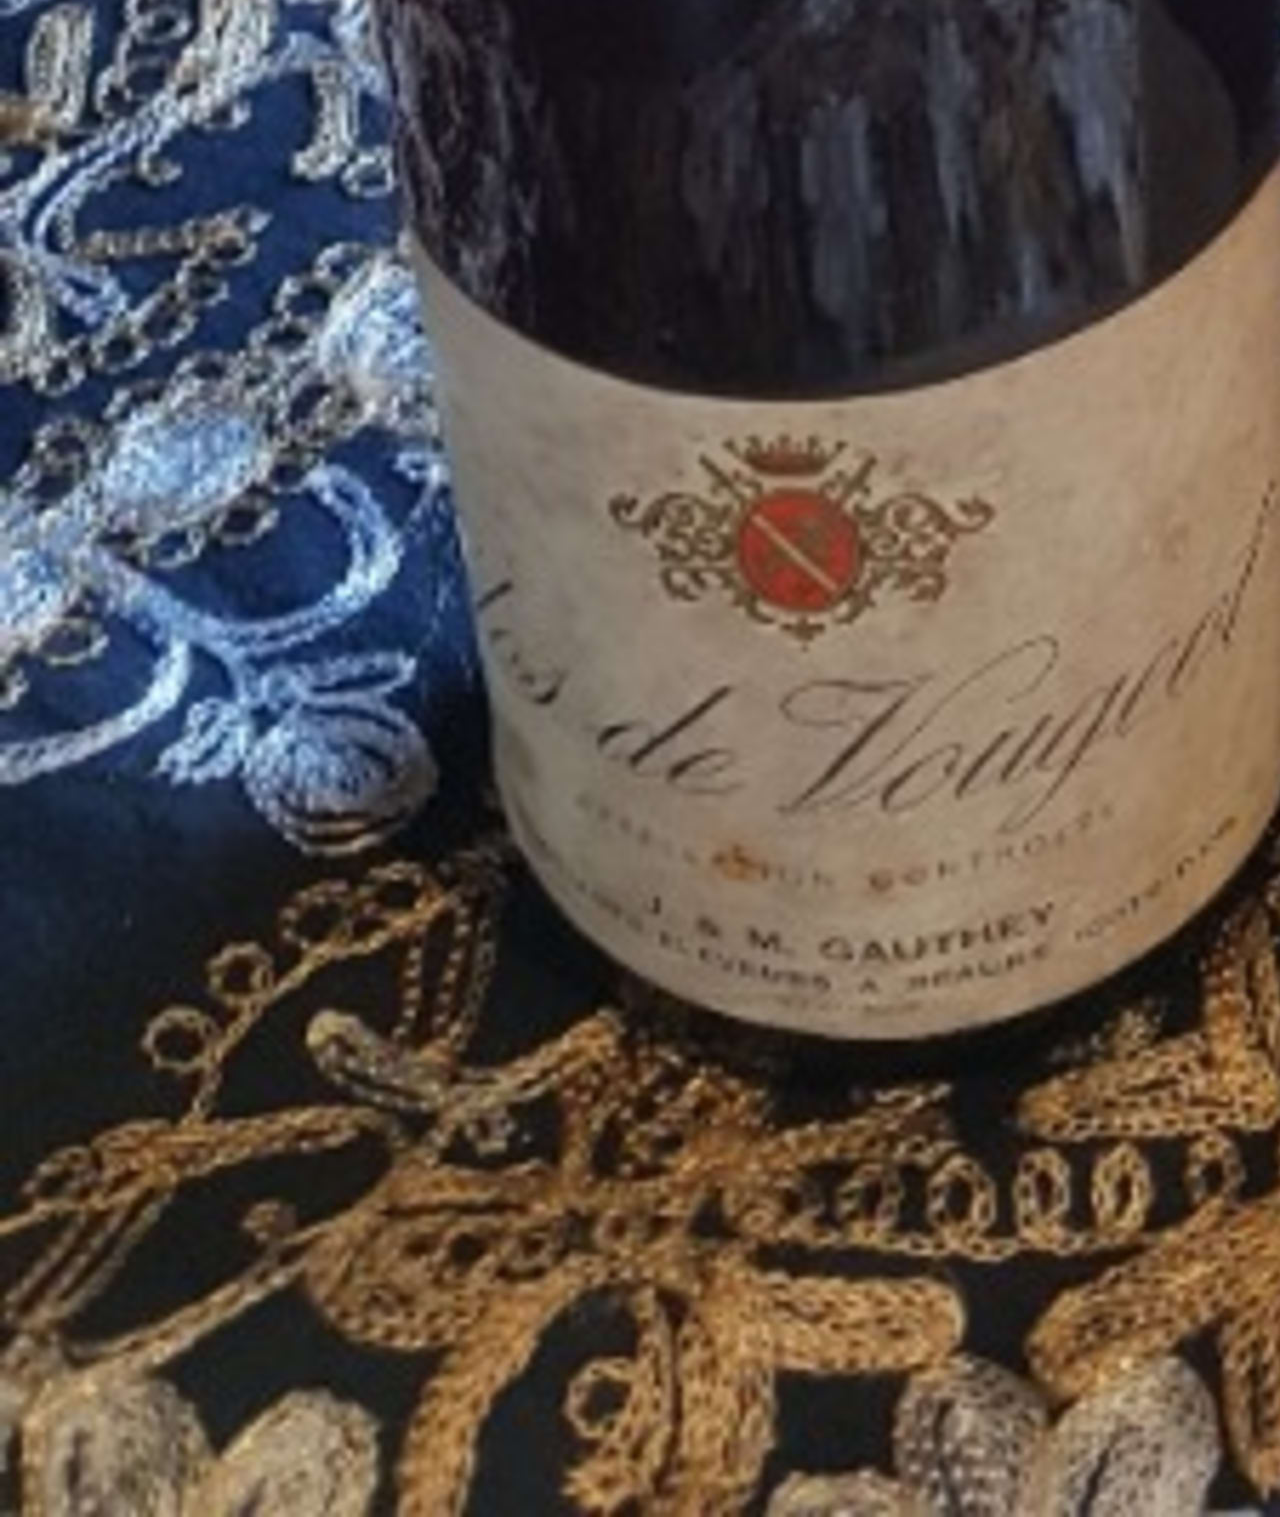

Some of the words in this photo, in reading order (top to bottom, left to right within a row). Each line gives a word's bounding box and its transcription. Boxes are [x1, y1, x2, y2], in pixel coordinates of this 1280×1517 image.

[594, 683, 748, 798] de
[776, 478, 1277, 834] Vougeot
[818, 901, 1056, 965] GAUTHEY
